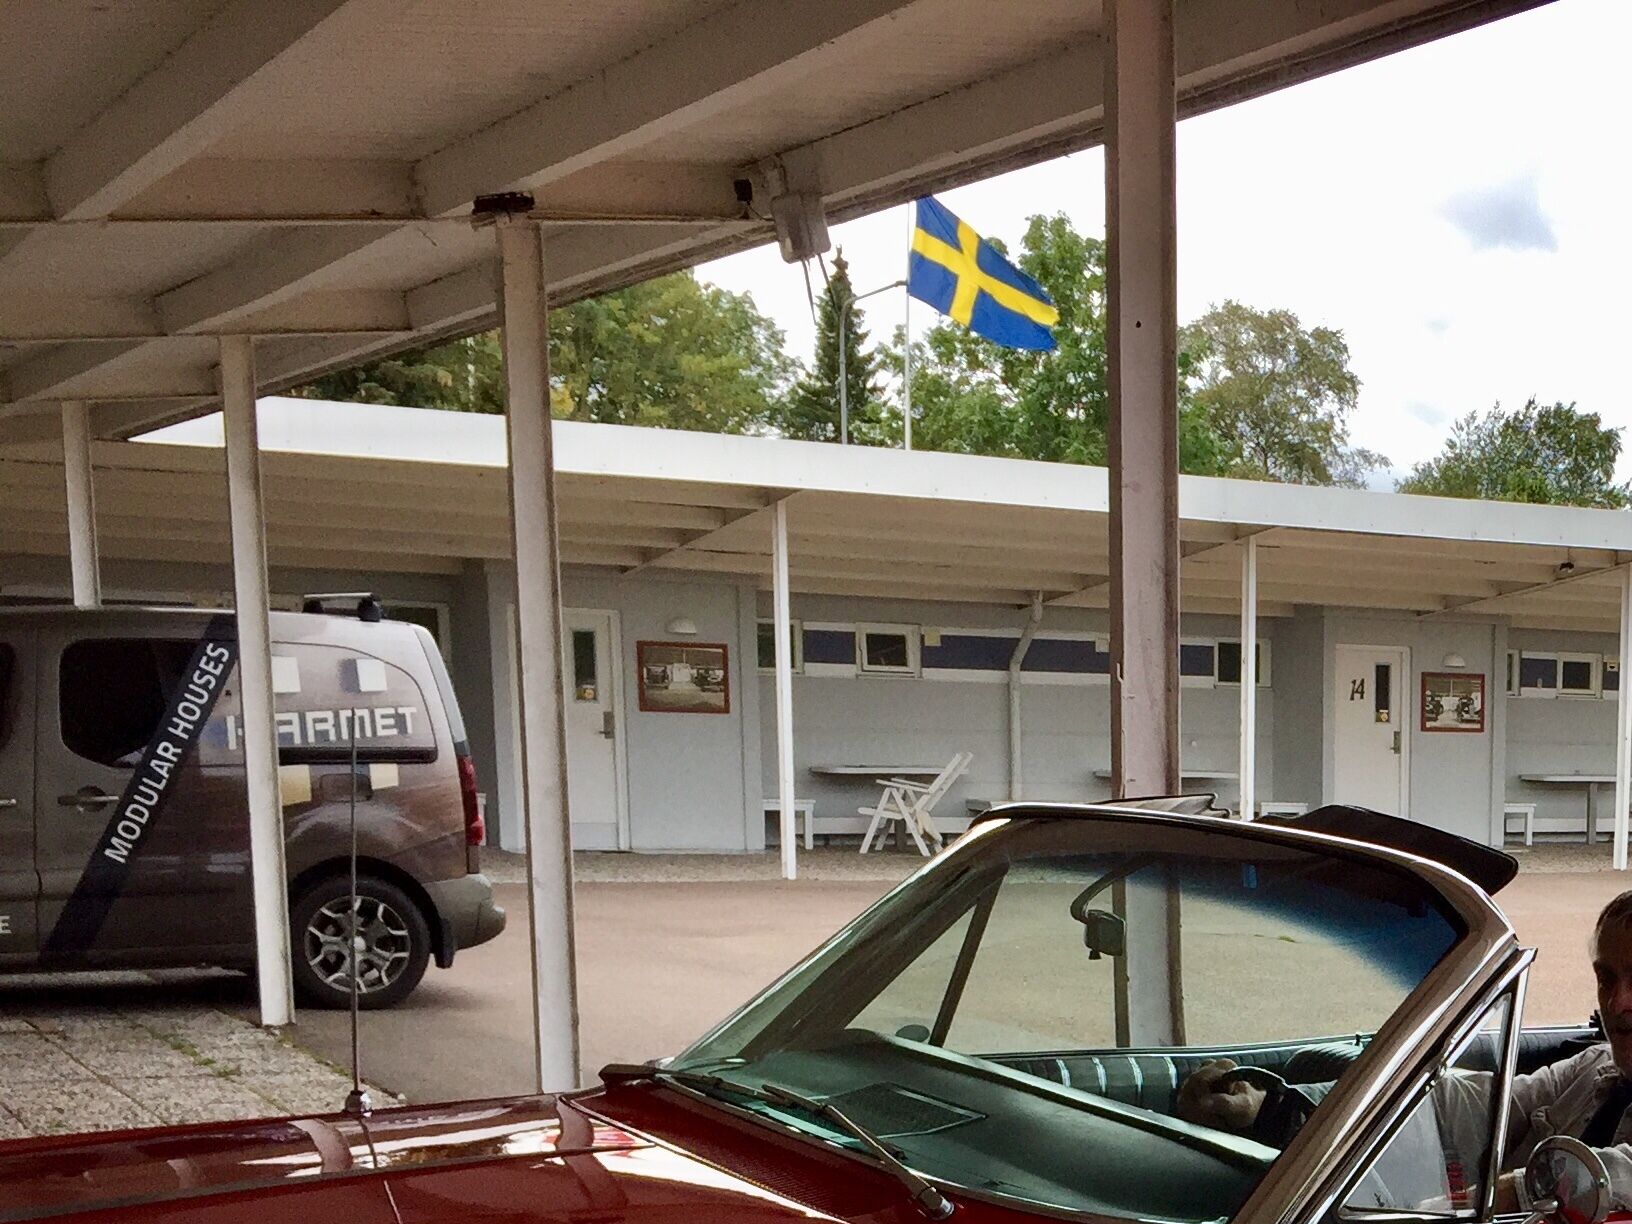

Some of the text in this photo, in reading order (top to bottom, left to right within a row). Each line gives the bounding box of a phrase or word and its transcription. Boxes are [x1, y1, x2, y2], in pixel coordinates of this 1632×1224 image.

[1350, 678, 1365, 701] 14
[103, 642, 230, 864] MODULAR HOUSES
